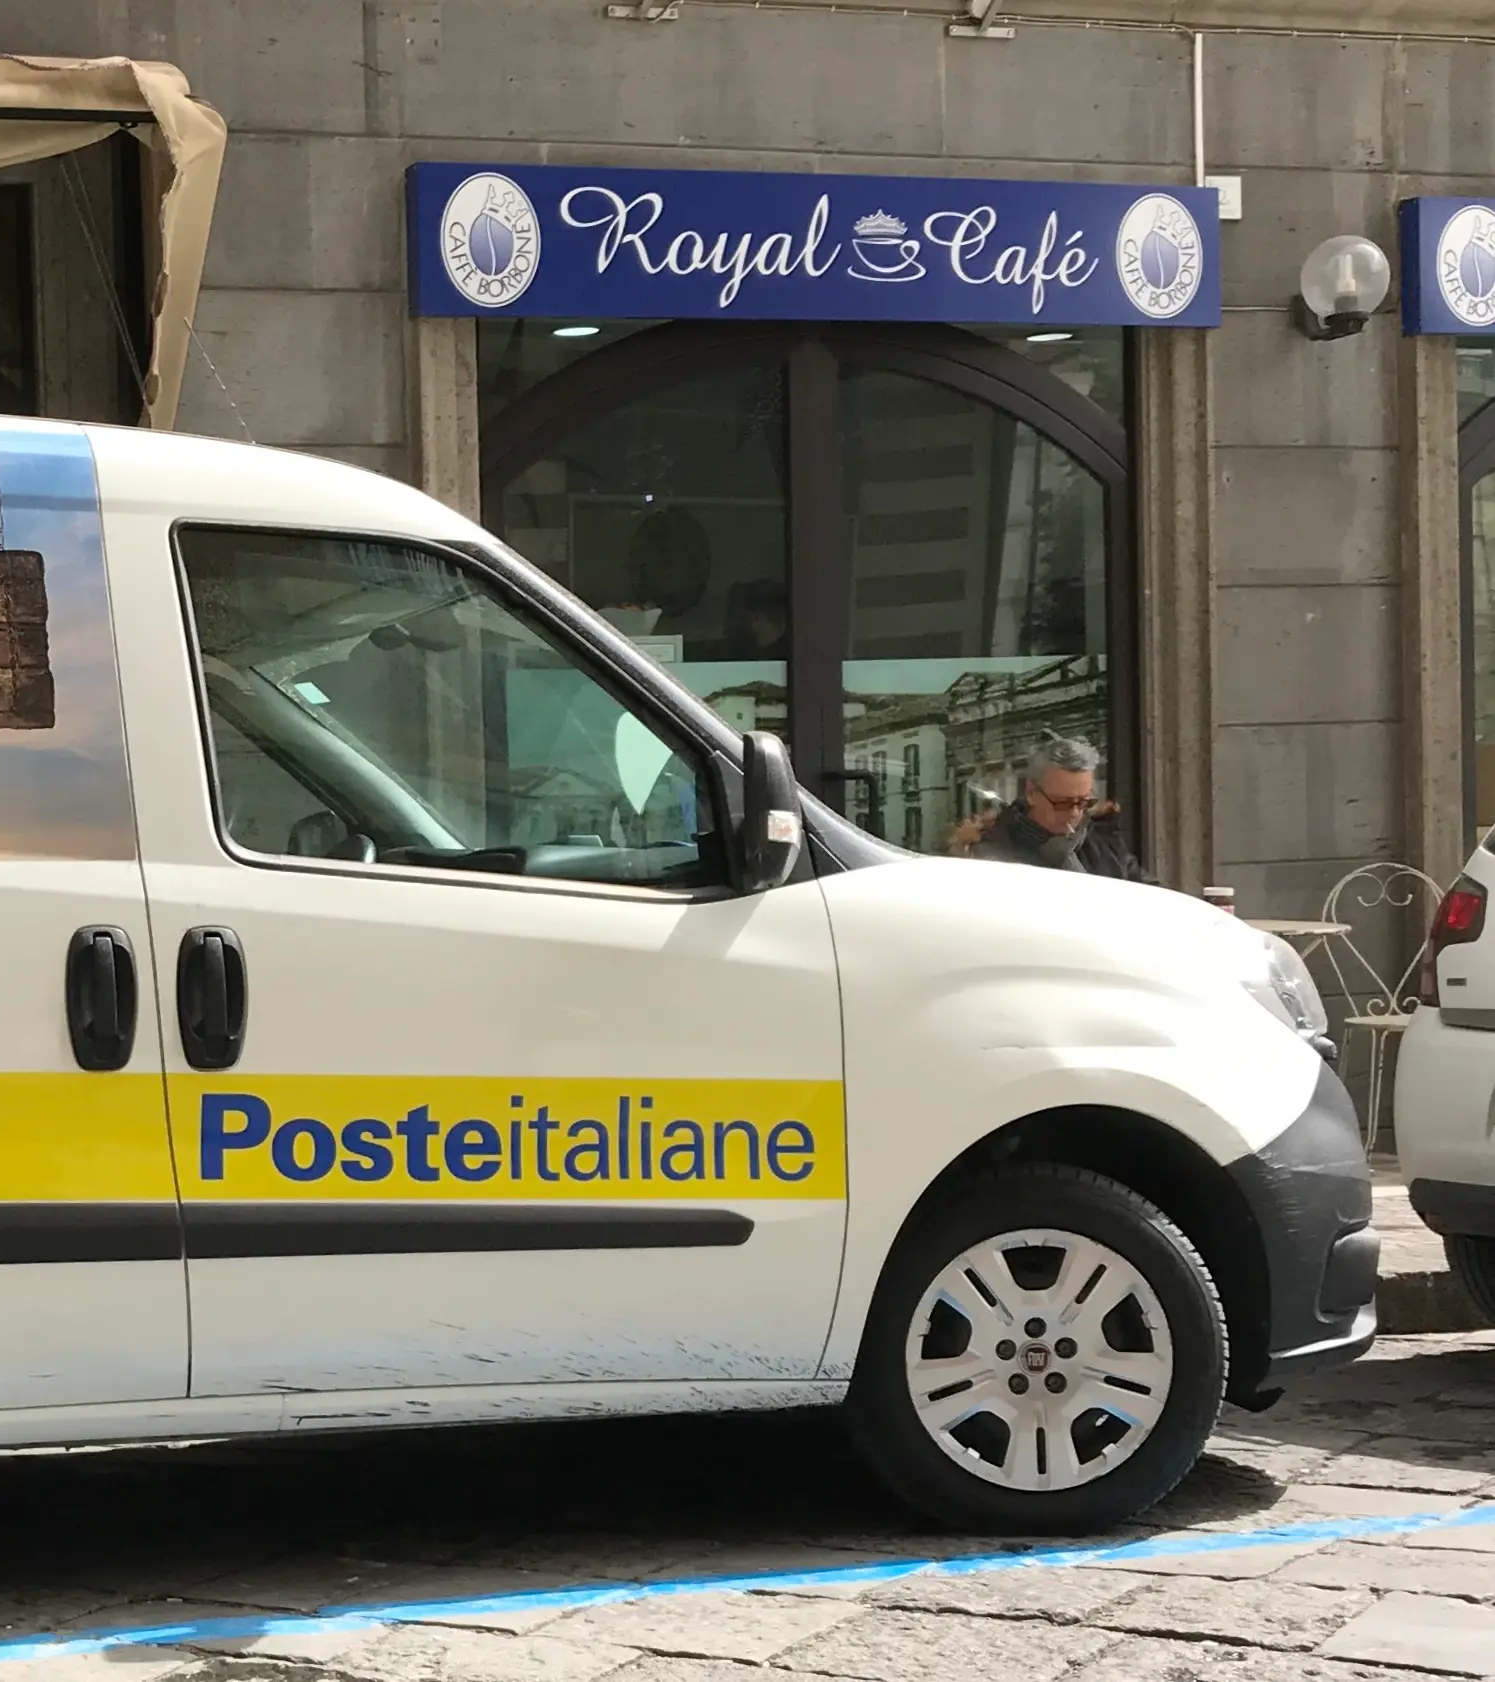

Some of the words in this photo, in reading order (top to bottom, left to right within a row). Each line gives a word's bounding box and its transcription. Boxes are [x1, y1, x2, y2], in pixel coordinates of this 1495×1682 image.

[477, 222, 532, 297] BORBONE
[560, 186, 841, 308] Royal
[924, 206, 1099, 314] Café
[1148, 239, 1196, 309] BORBONE
[200, 1093, 815, 1182] Posteitaliane
